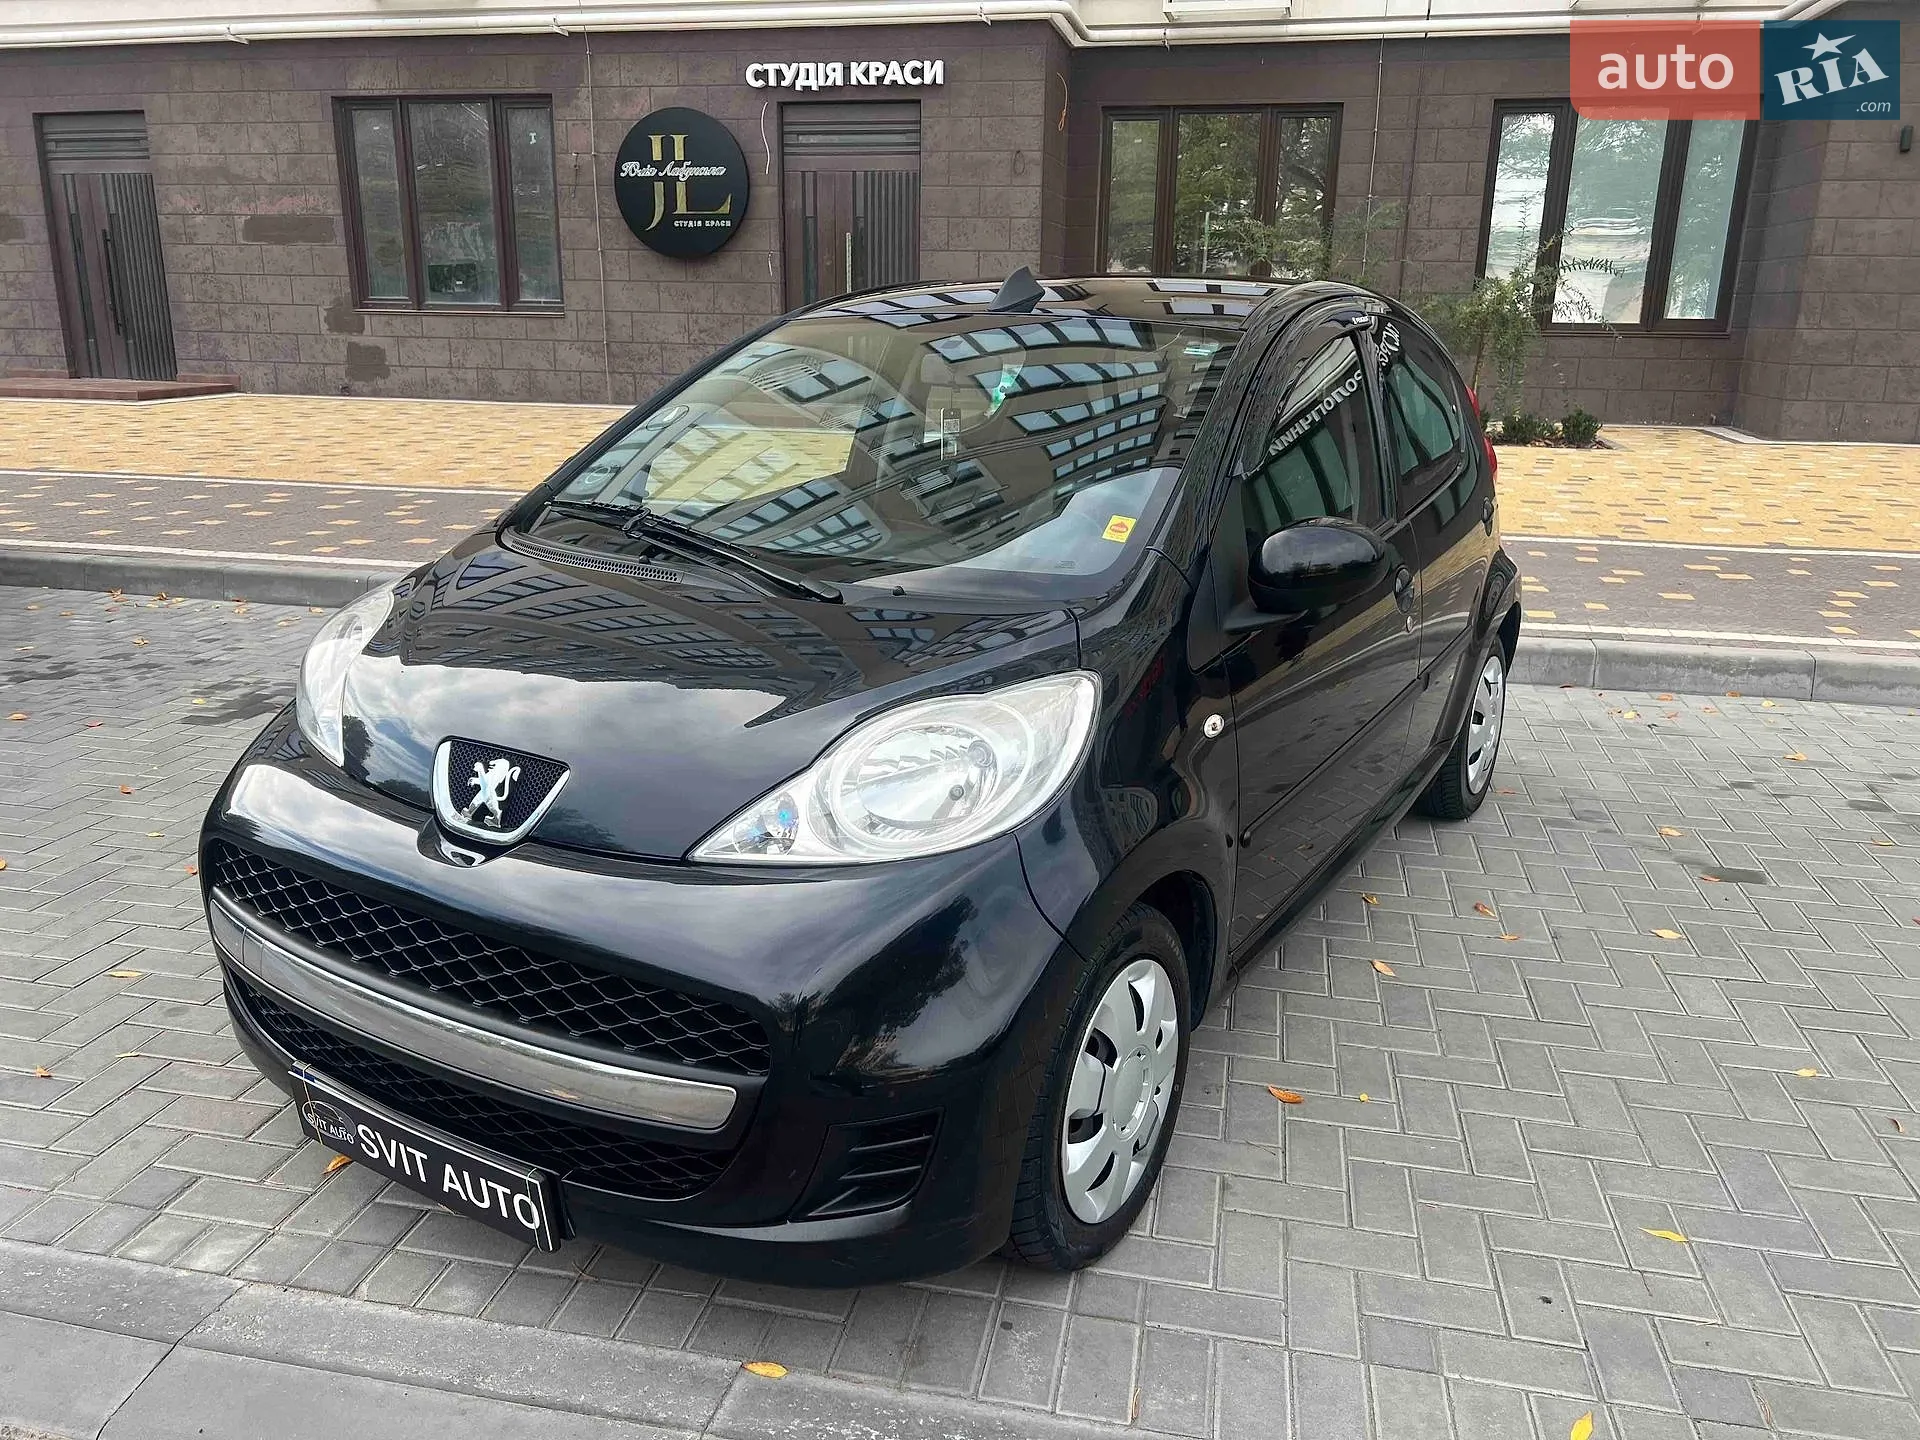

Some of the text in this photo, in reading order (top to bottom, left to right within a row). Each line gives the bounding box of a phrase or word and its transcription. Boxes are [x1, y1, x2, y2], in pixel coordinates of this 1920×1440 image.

[745, 59, 945, 92] СТУДІЯ КРАСИ
[673, 219, 732, 228] СТУДІЯ КРАСИ
[307, 1112, 355, 1145] SVIT AUTO
[357, 1123, 542, 1230] SVIT AUTO
